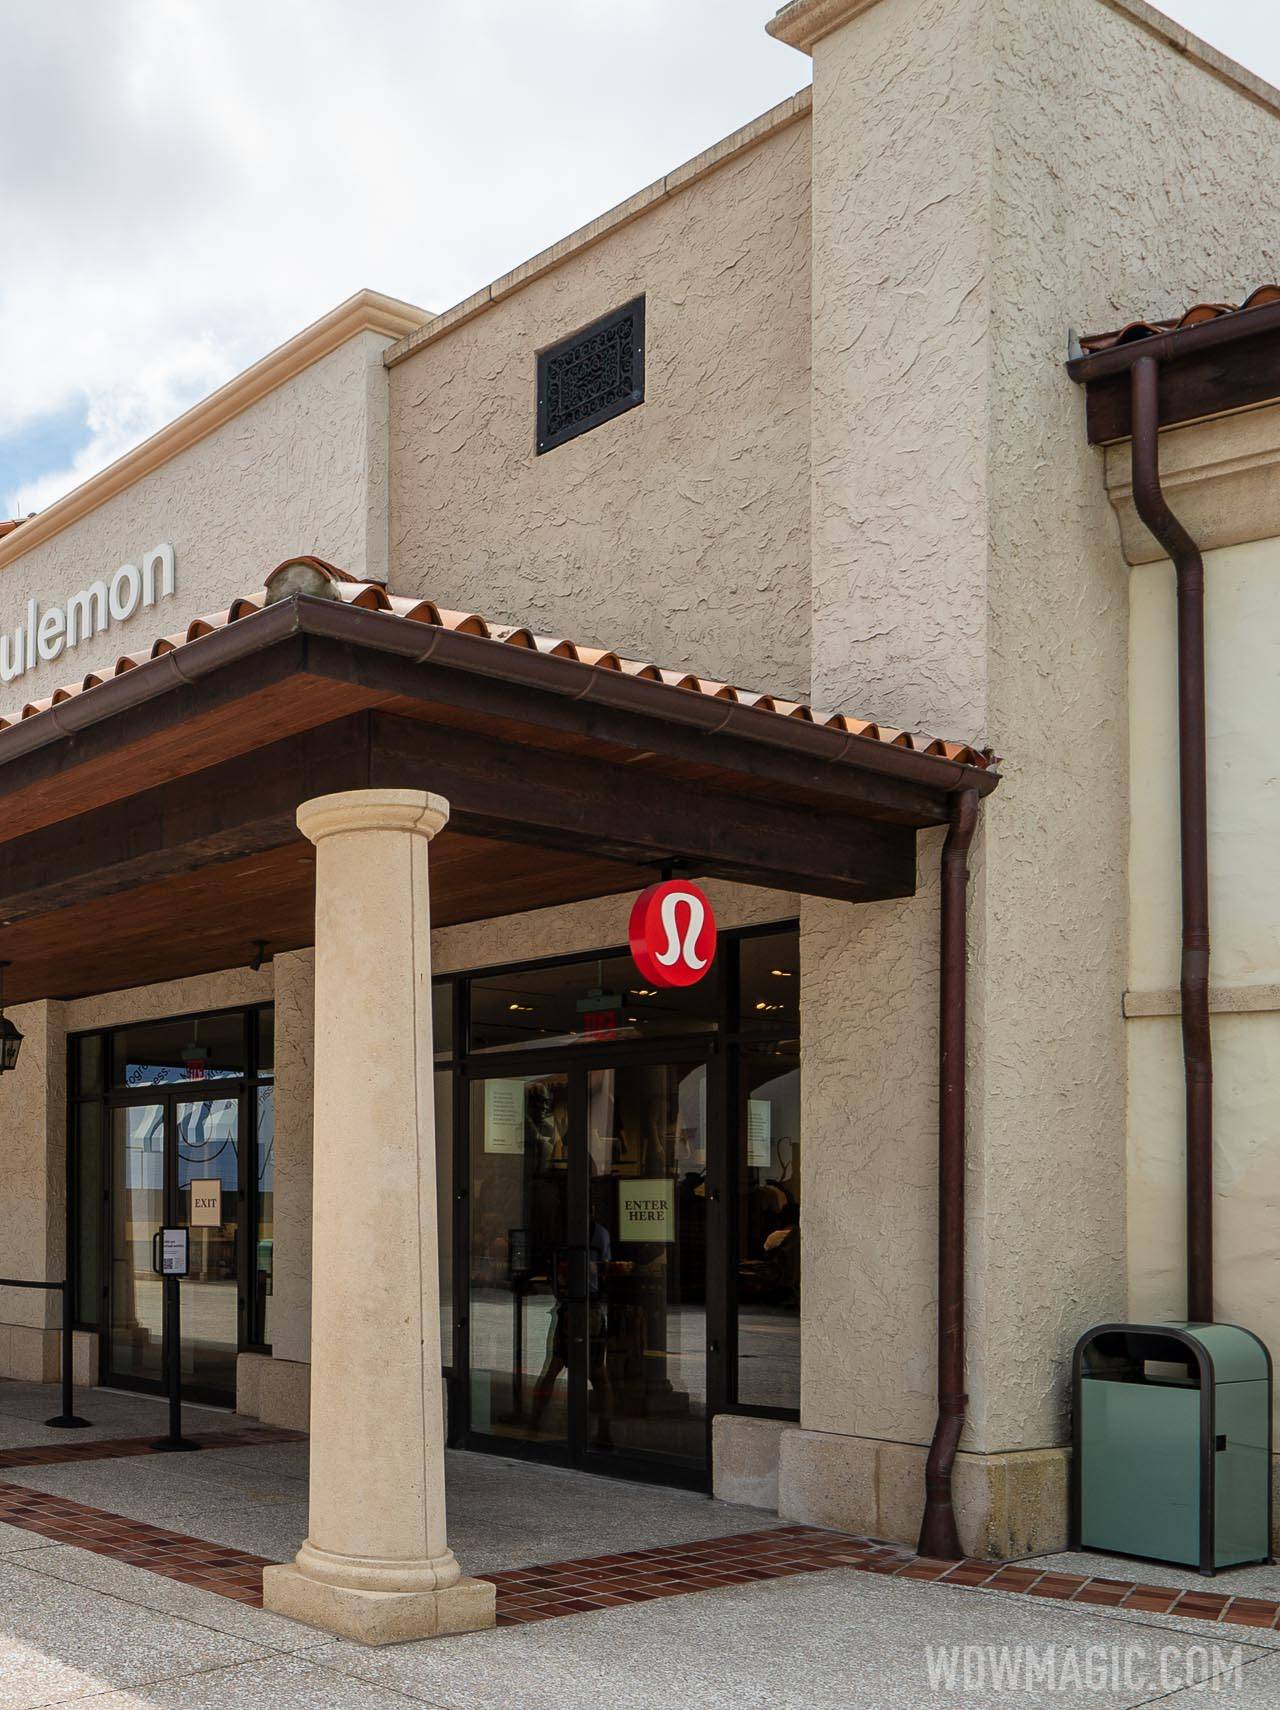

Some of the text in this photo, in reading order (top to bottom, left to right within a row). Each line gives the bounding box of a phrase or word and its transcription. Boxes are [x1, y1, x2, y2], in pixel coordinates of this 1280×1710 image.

[194, 1198, 217, 1208] EXIT
[624, 1200, 669, 1210] ENTER
[628, 1211, 665, 1221] HERE
